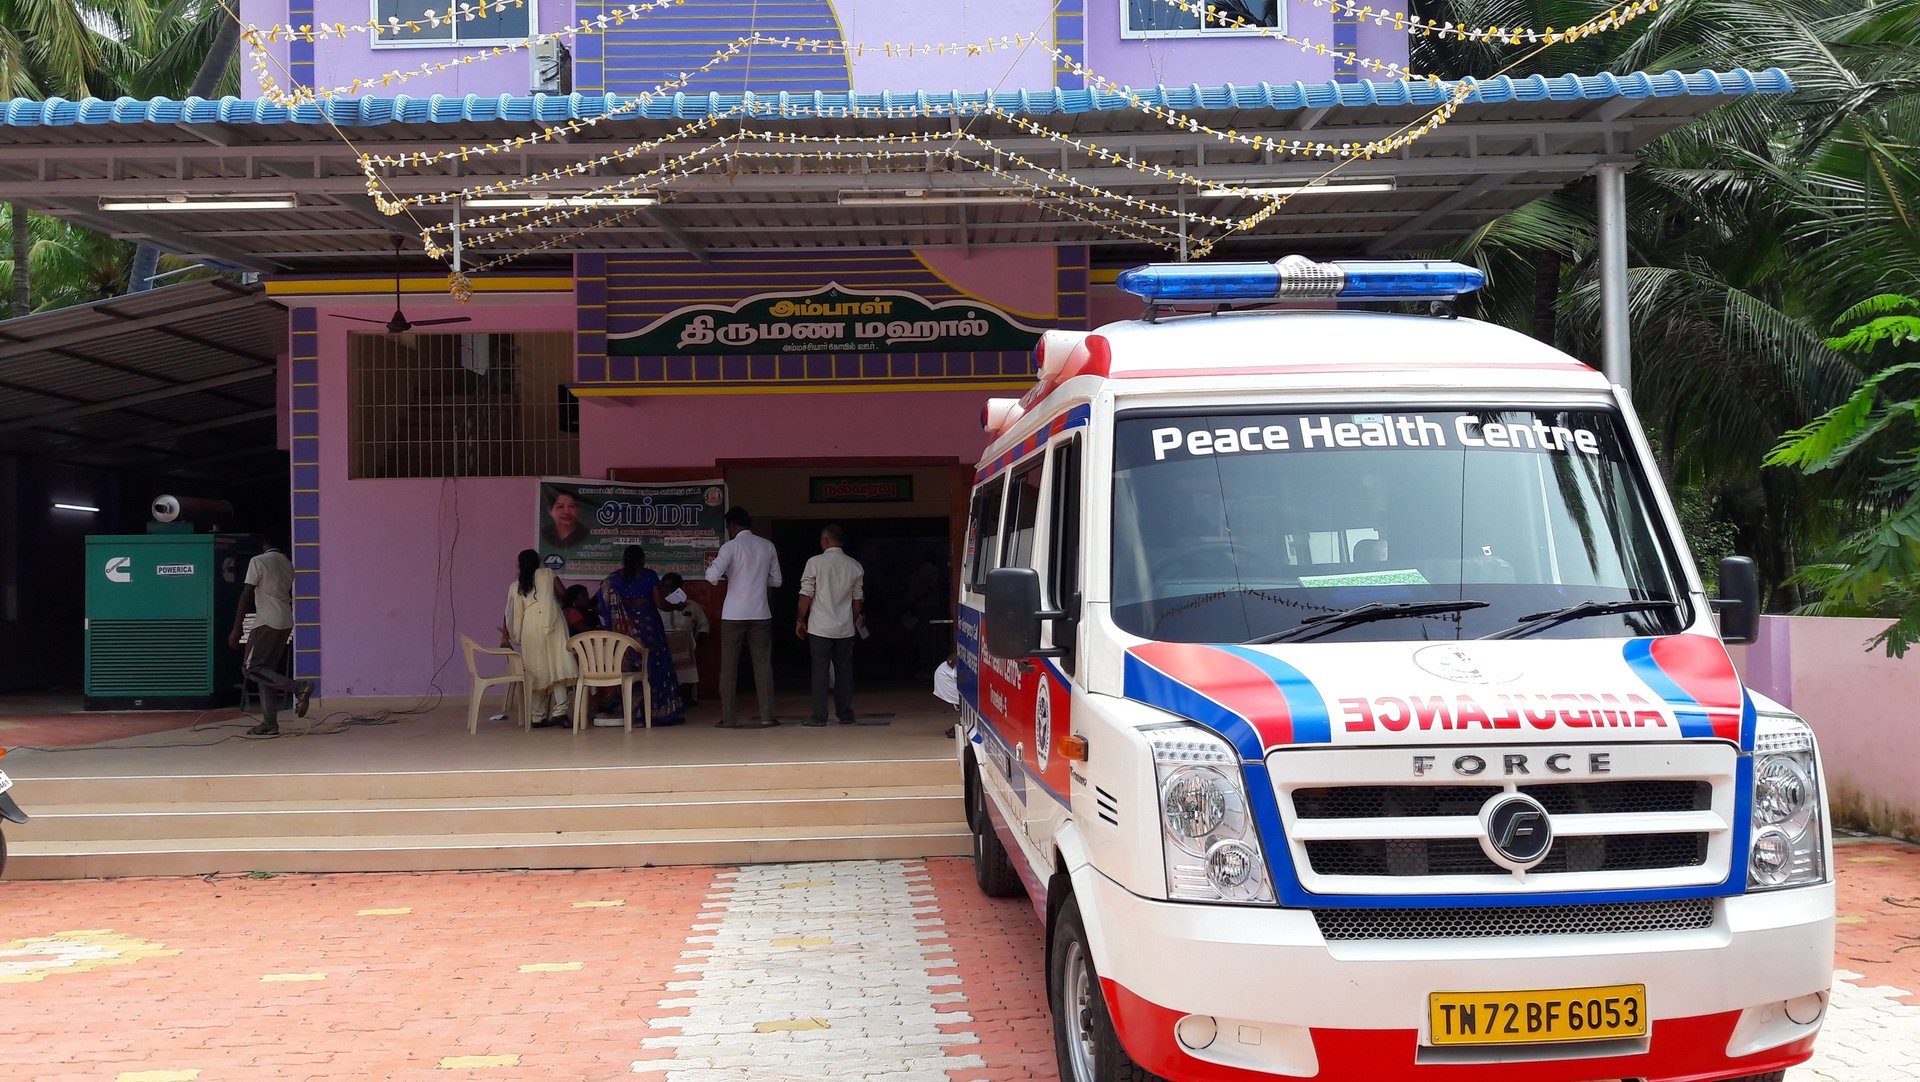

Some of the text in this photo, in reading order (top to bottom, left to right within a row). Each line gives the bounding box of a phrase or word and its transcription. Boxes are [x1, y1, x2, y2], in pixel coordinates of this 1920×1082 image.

[768, 297, 893, 317] அம்பாள்
[676, 311, 989, 350] திருமண மஹால்
[1151, 416, 1600, 460] Peace Health Centre
[597, 497, 703, 526] அம்மா
[158, 566, 193, 574] POWERICA
[1412, 752, 1611, 776] FORCE
